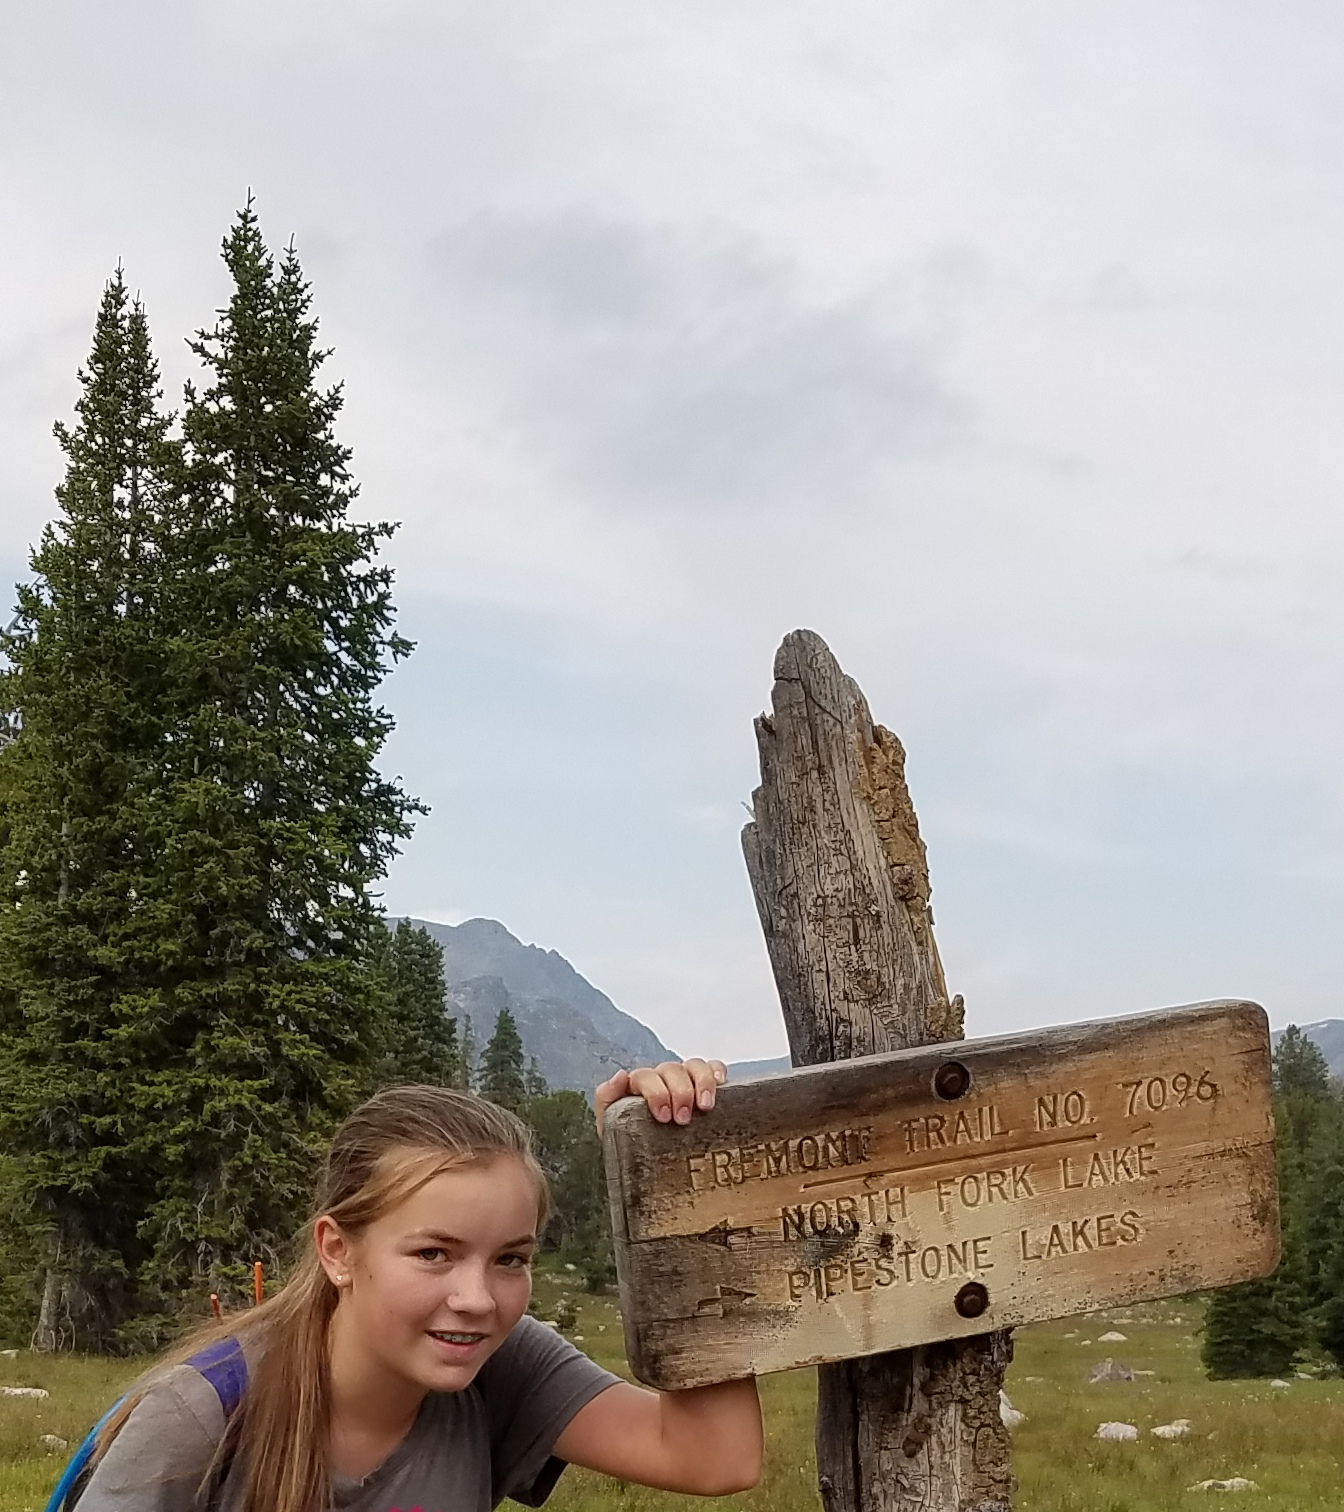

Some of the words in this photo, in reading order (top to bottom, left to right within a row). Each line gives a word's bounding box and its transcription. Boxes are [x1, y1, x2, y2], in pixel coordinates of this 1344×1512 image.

[687, 1127, 873, 1190] FREMONT
[904, 1105, 1011, 1153] TRAIL
[1038, 1091, 1096, 1130] NO.
[1120, 1070, 1218, 1117] 7096
[780, 1186, 906, 1242] NORTH
[936, 1164, 1034, 1213] FORK
[1061, 1143, 1159, 1190] LAKE
[788, 1236, 994, 1302] PIPESTONE
[1021, 1211, 1142, 1261] LAKES
